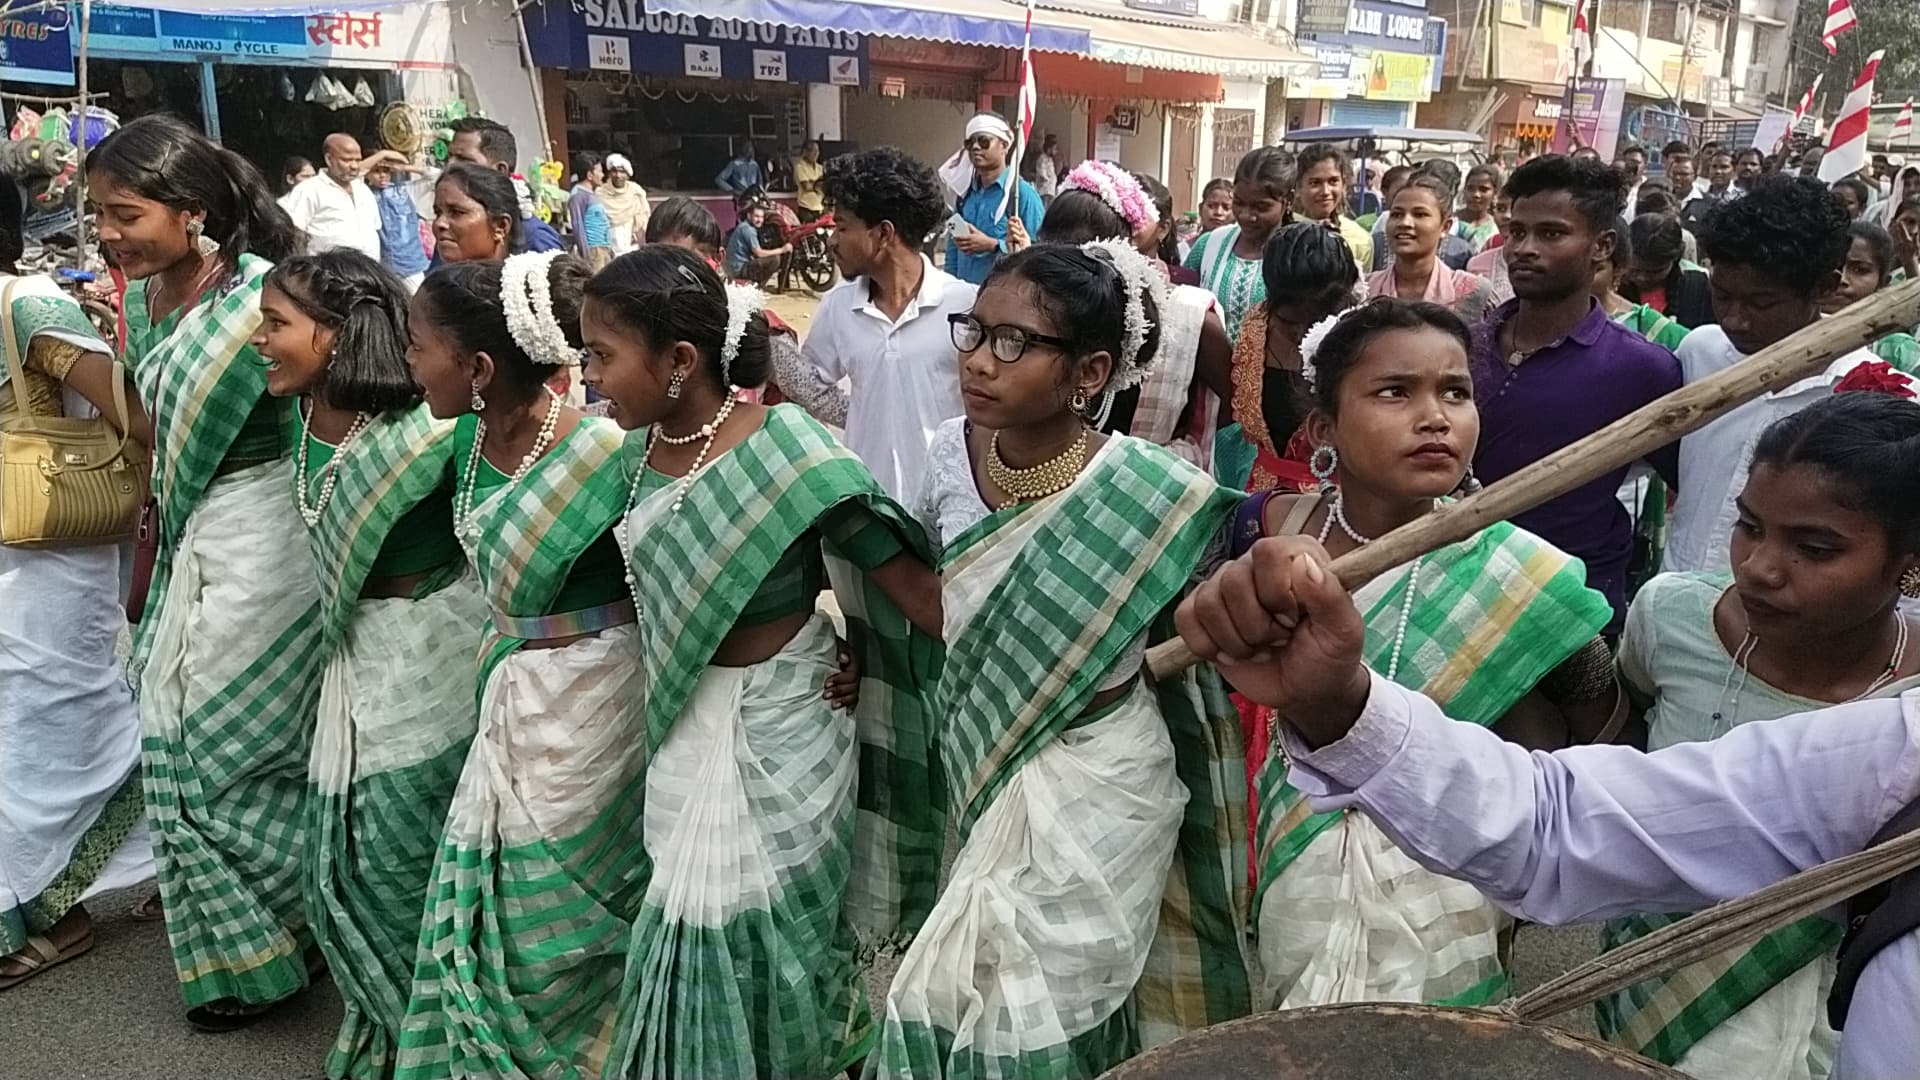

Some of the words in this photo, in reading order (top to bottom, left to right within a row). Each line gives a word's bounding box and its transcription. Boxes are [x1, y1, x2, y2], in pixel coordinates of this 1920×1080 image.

[1386, 13, 1424, 41] LODGE
[172, 38, 223, 52] MANOJ
[690, 64, 719, 73] BAJAJ
[1123, 48, 1231, 73] SAMSUNG
[1236, 61, 1290, 75] POINT
[759, 65, 781, 76] TVS
